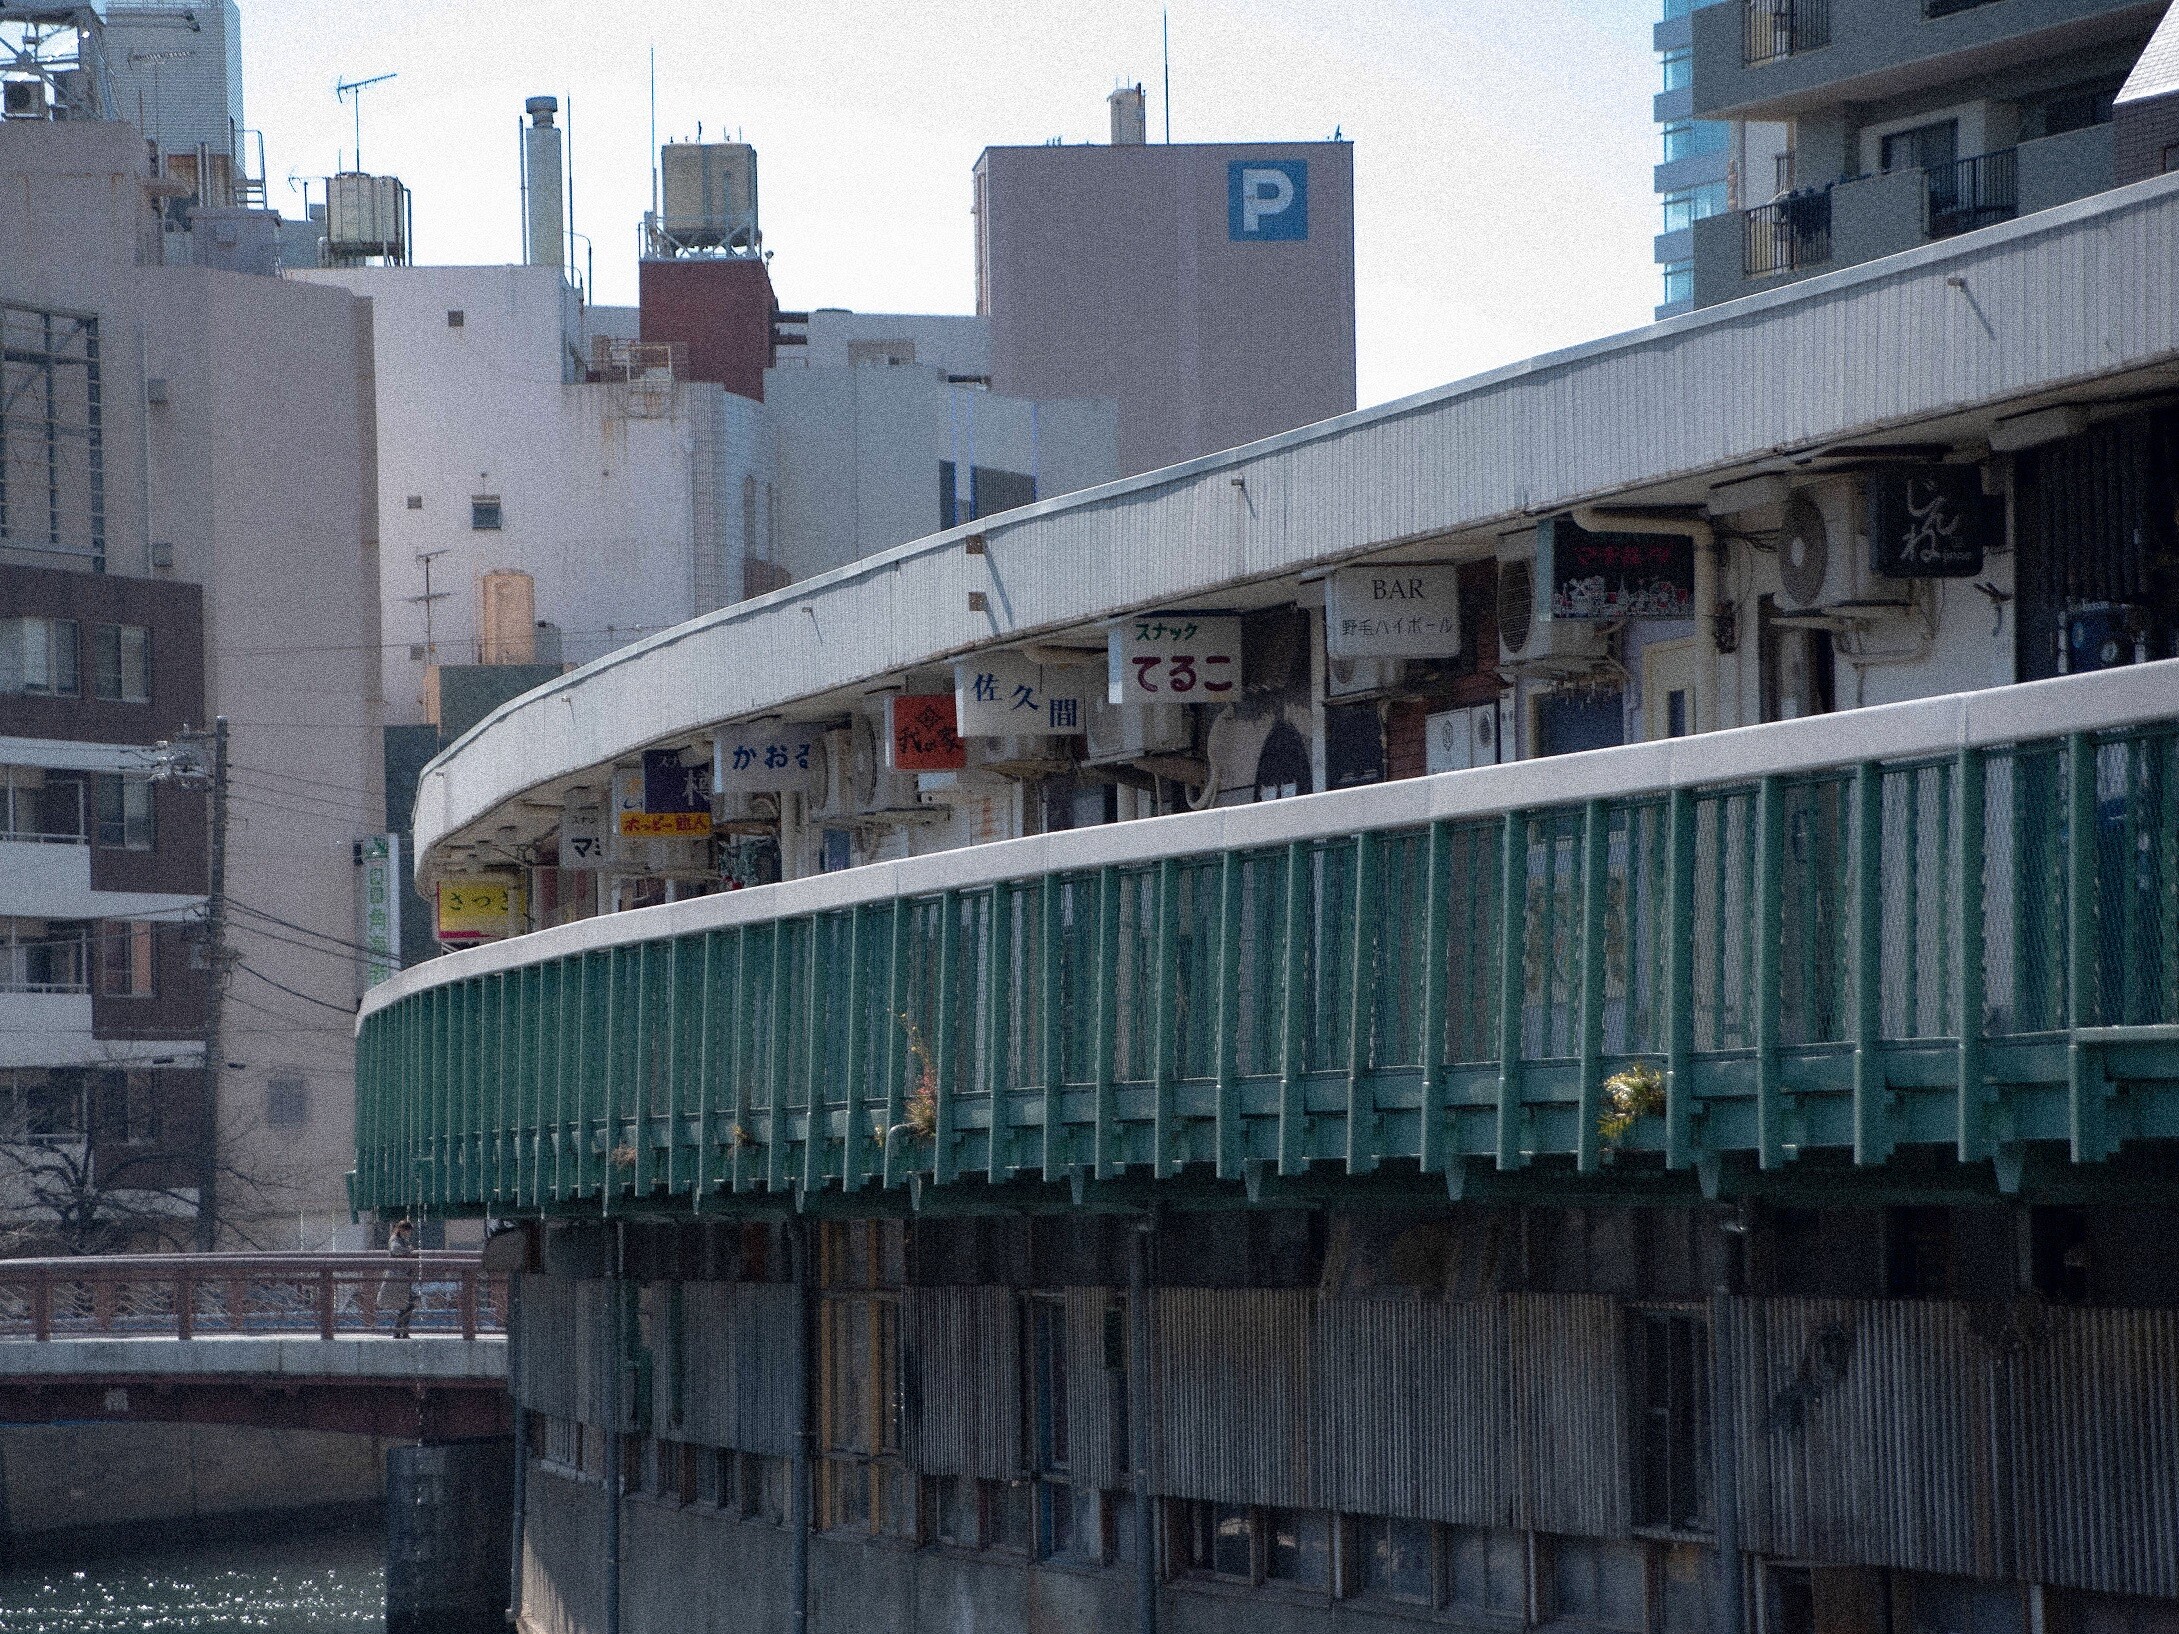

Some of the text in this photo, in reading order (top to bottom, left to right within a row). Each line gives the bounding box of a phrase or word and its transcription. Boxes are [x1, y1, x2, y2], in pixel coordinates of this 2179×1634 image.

[1243, 169, 1294, 231] P
[1371, 579, 1425, 599] BAR
[1135, 622, 1198, 642] スナック
[1342, 617, 1453, 636] 野毛ハイボール
[1131, 655, 1233, 692] てるこ
[972, 673, 1078, 728] 佐久間
